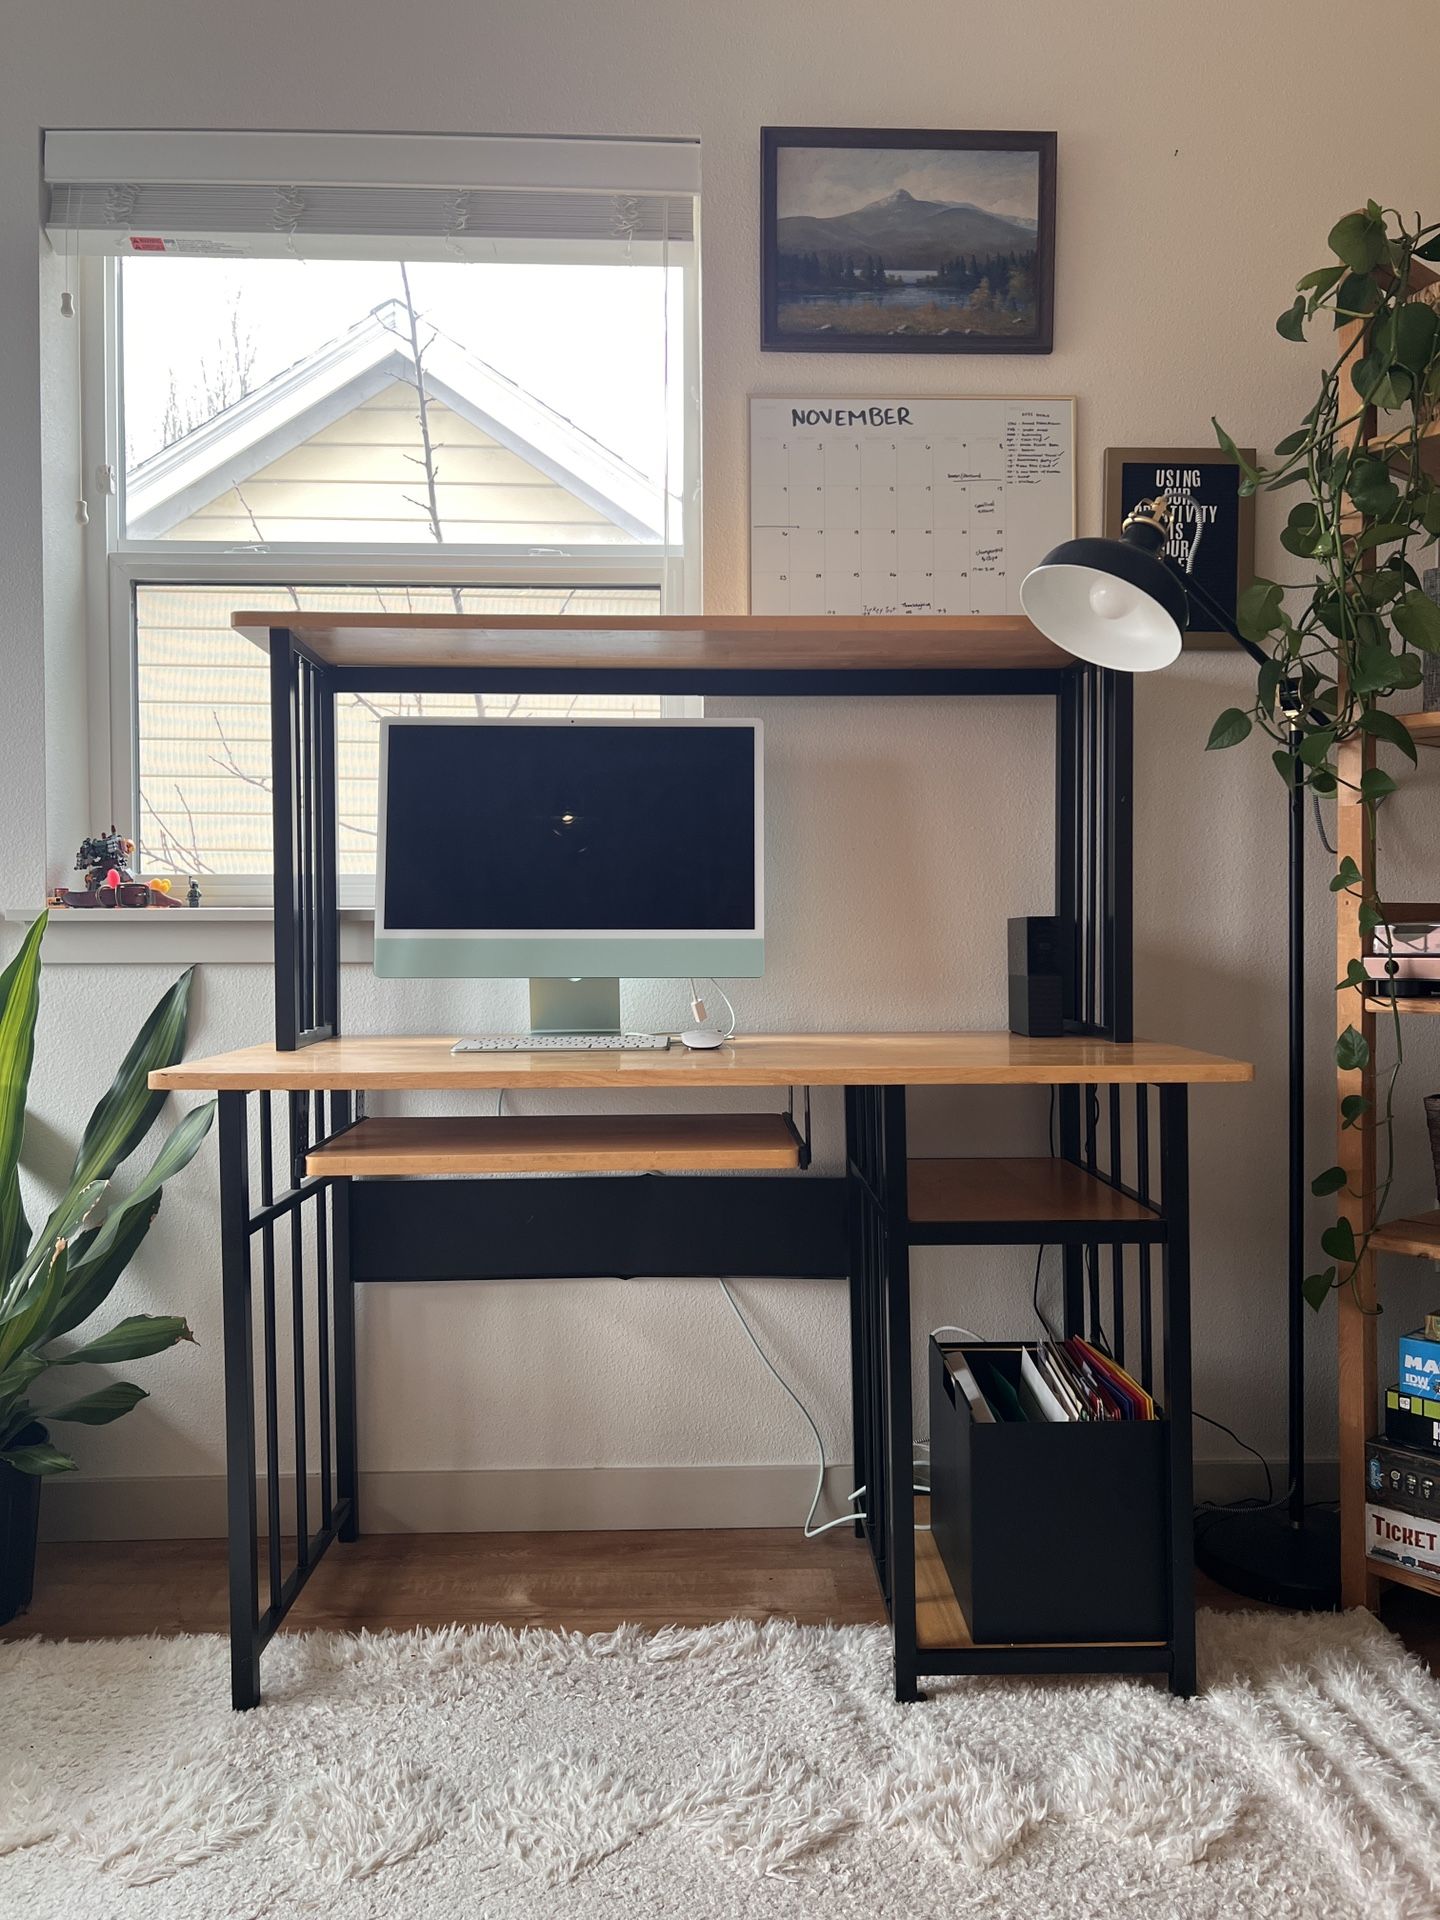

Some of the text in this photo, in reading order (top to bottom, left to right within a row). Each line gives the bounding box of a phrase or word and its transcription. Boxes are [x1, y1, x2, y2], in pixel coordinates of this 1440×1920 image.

[791, 406, 914, 427] NOVEMBER
[1156, 469, 1200, 487] USING
[1169, 523, 1183, 540] IS
[1404, 1354, 1440, 1375] MA
[1405, 1373, 1429, 1388] IDW
[1372, 1514, 1438, 1551] TICKET
